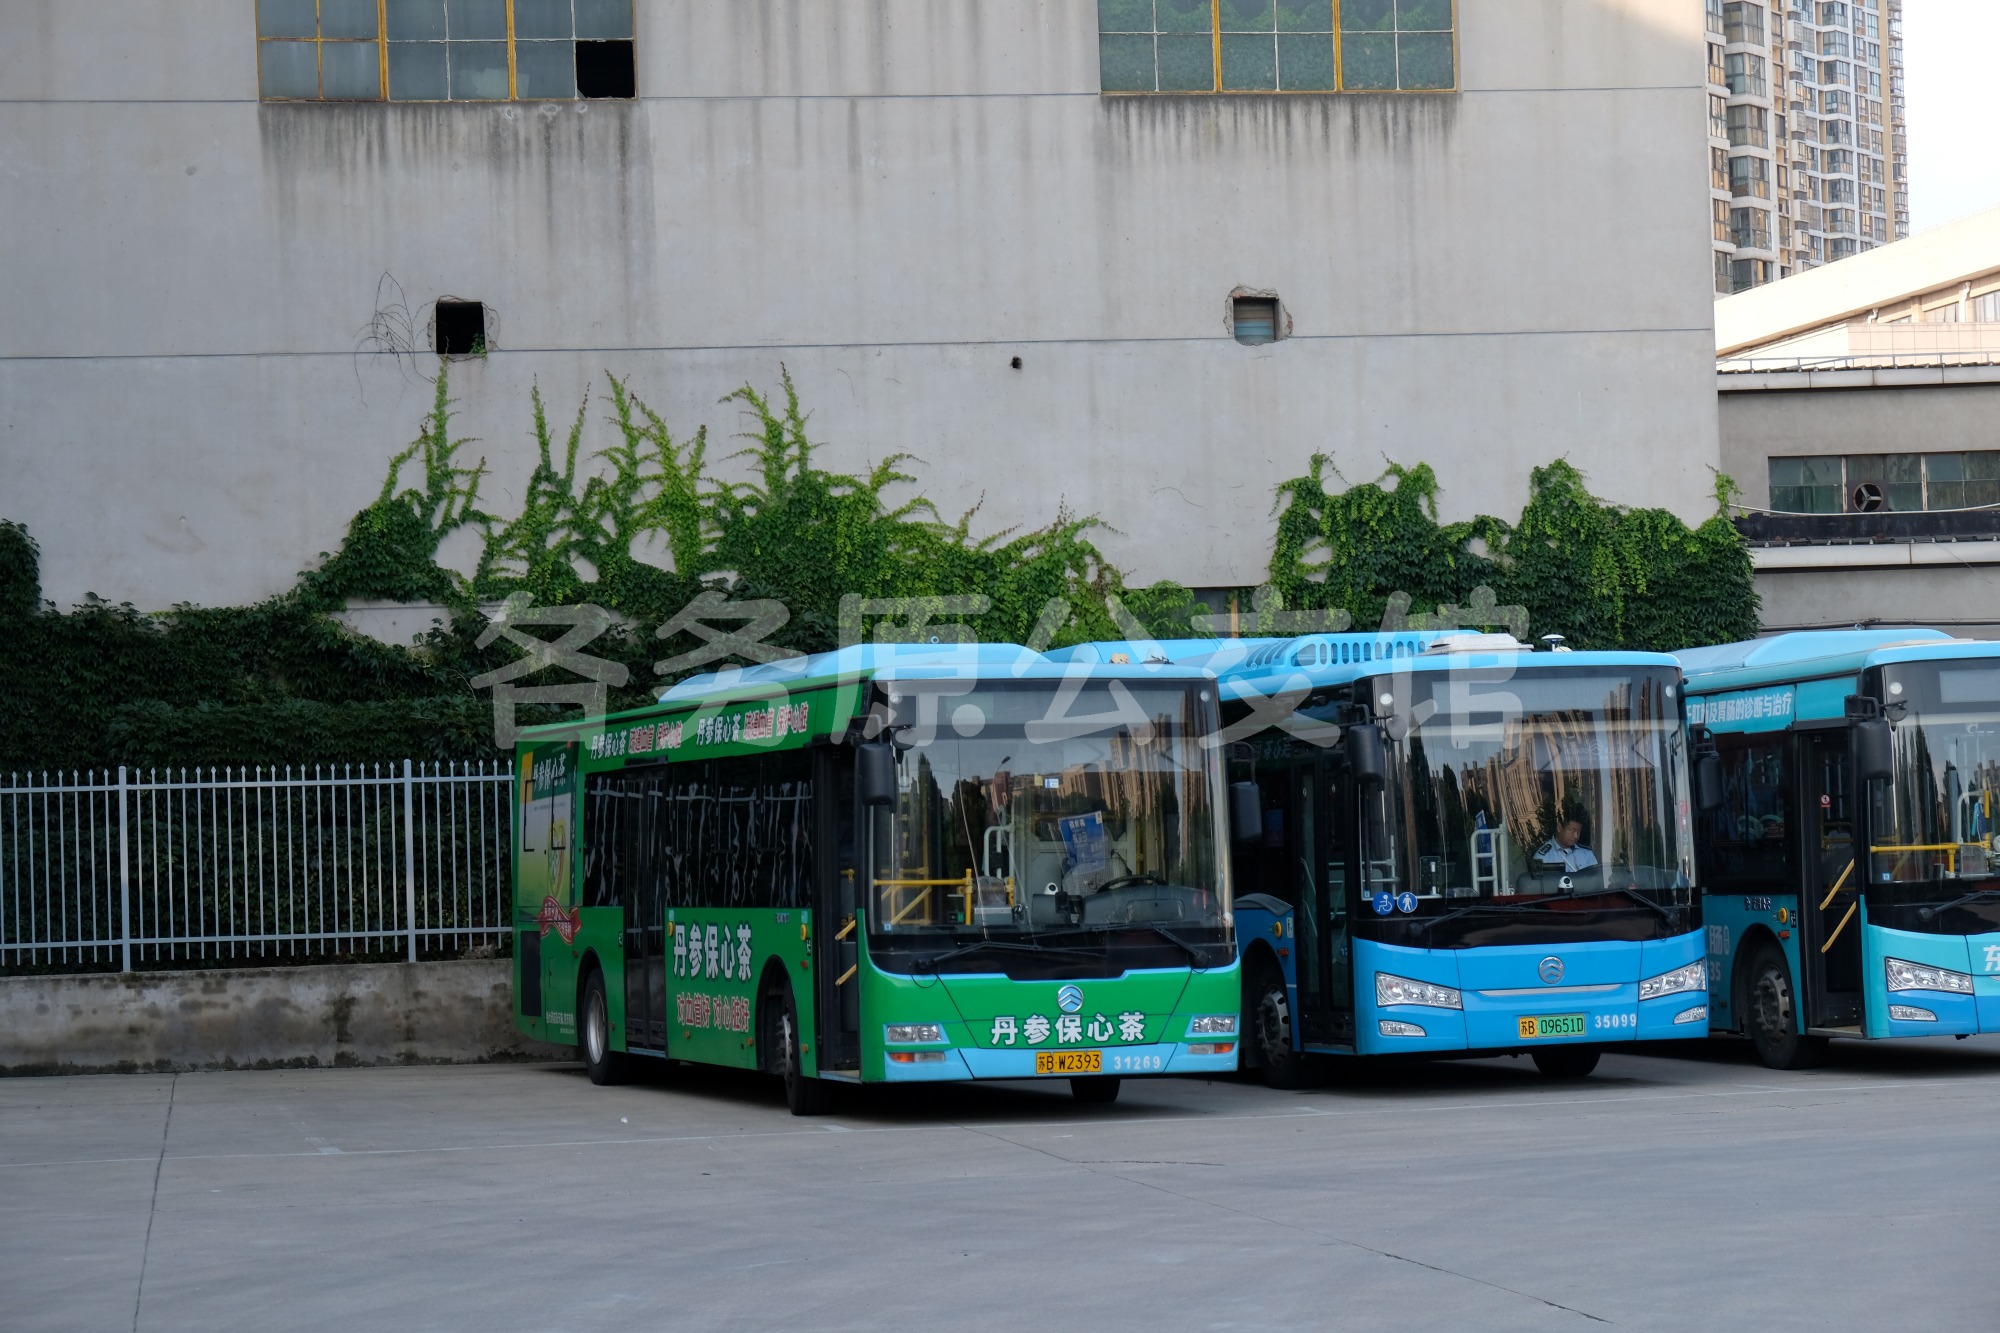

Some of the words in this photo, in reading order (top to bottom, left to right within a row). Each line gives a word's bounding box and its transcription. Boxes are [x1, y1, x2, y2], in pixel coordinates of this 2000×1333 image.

[590, 729, 627, 760] 丹参保心茶
[696, 712, 741, 745] 丹参保心茶
[673, 922, 752, 981] 丹参保心茶
[676, 991, 711, 1028] 对血管好
[1594, 1013, 1637, 1029] 35099
[991, 1011, 1145, 1046] 丹参保心茶
[1114, 1055, 1161, 1070] 31269
